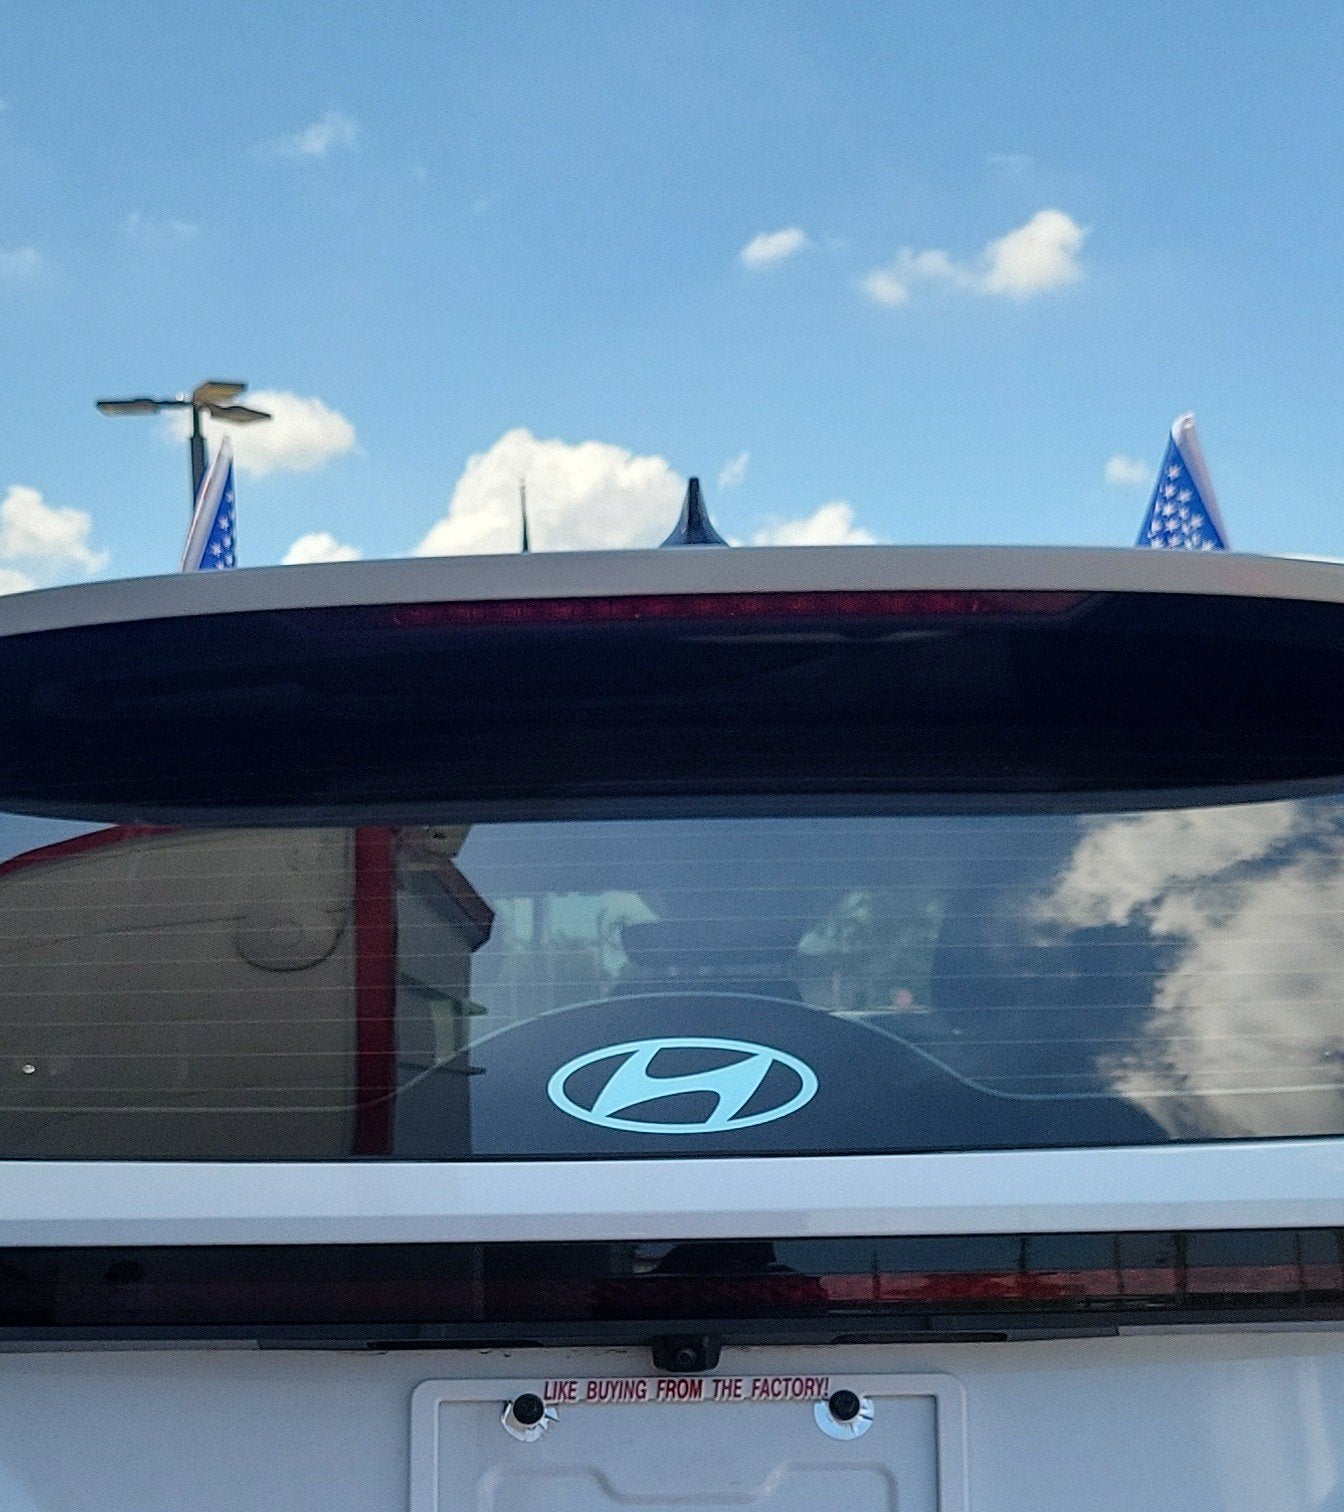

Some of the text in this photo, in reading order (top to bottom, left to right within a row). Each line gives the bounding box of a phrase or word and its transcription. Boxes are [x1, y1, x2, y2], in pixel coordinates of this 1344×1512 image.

[544, 1377, 830, 1400] LIKE BUYING FROM THE FACTORY!
